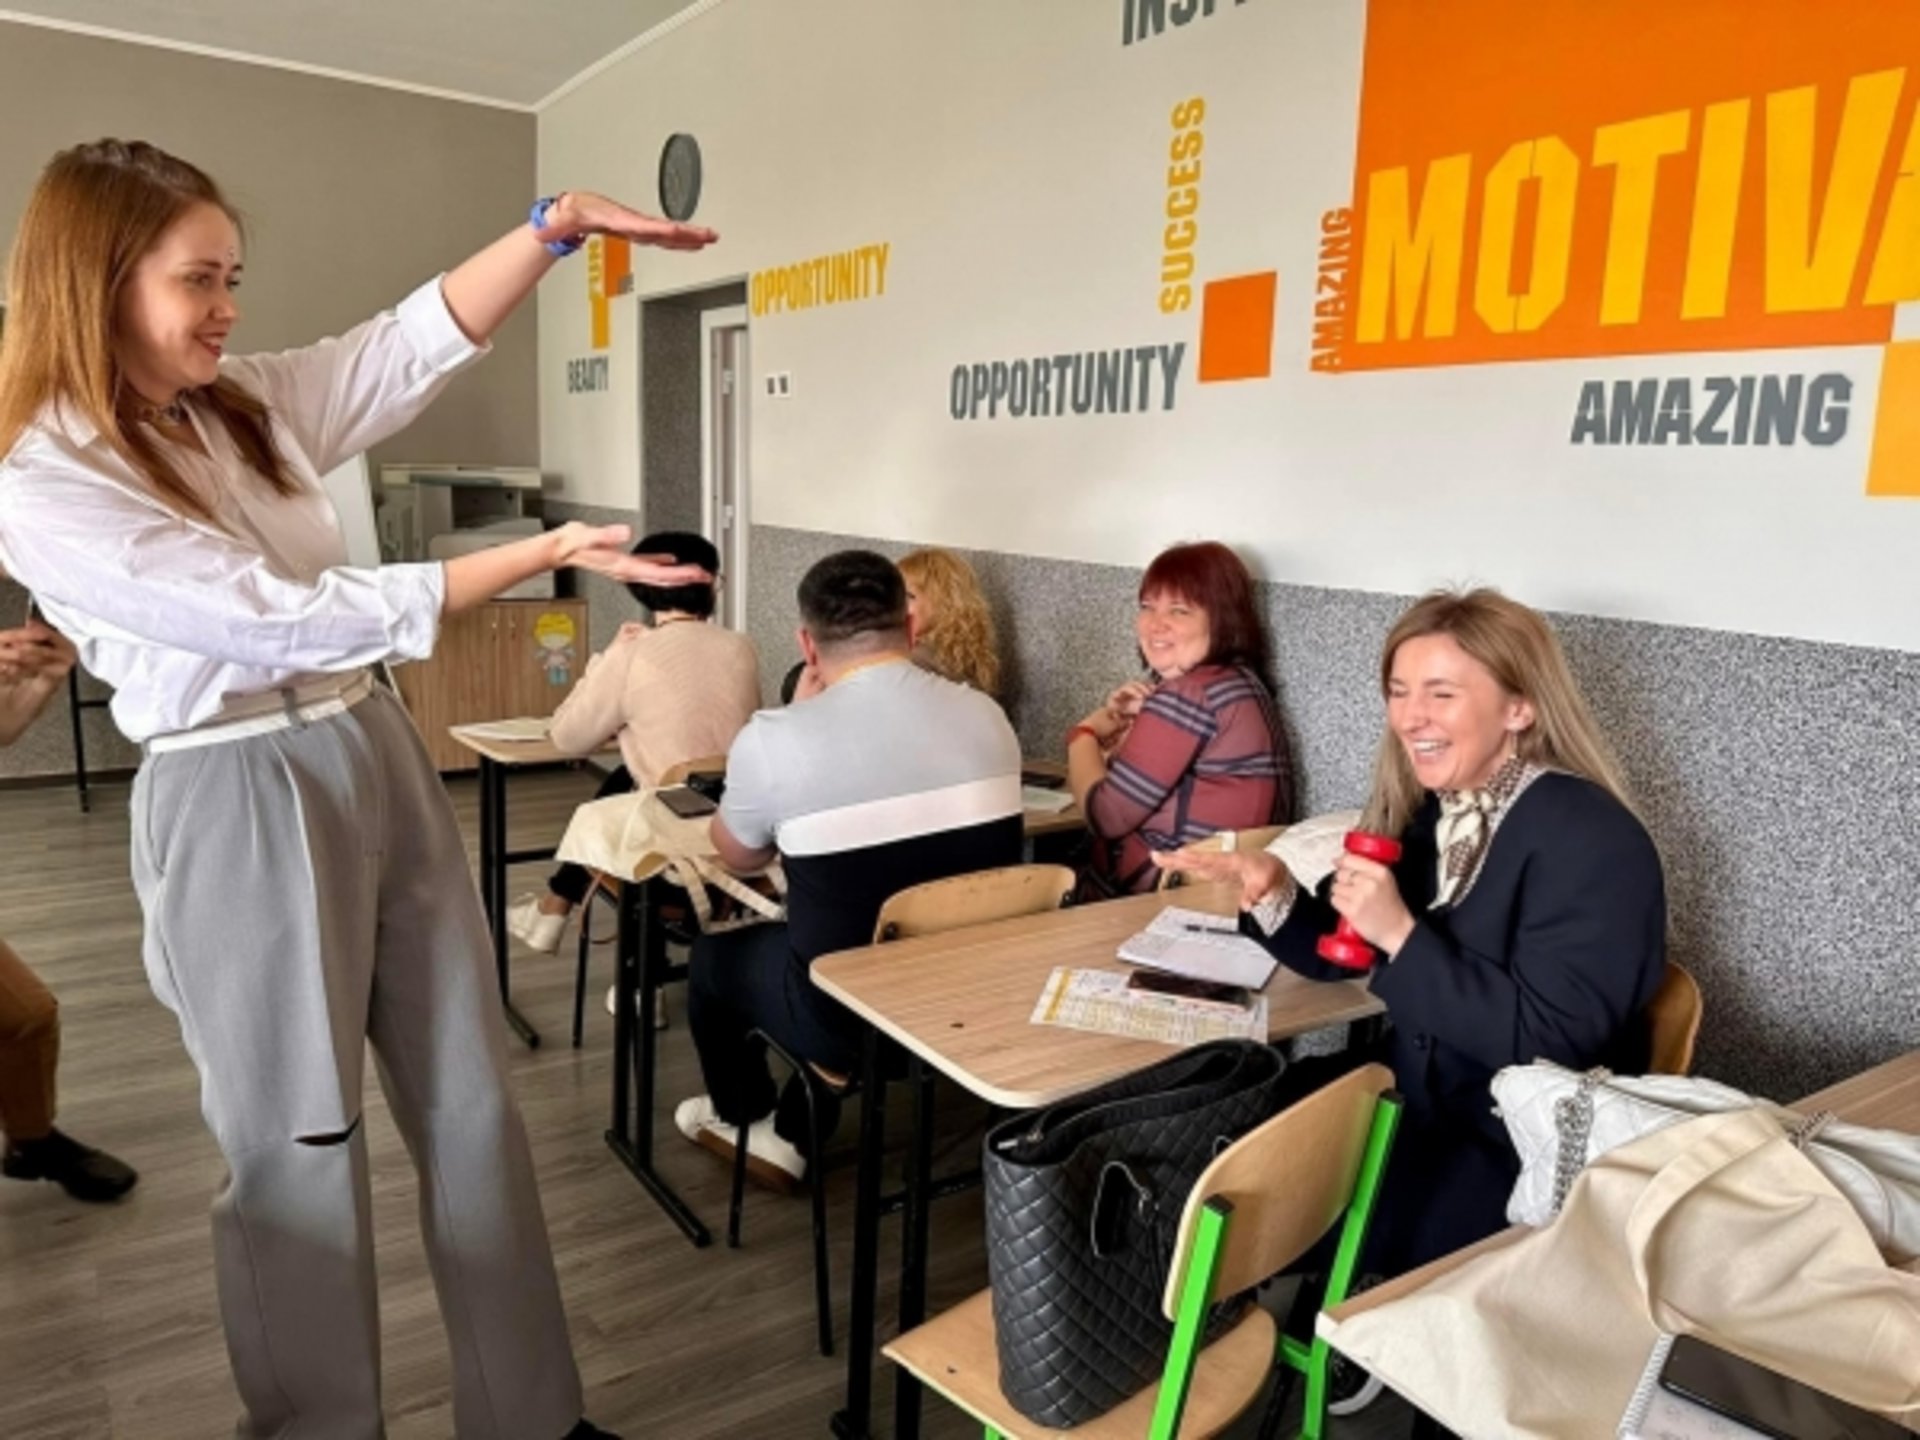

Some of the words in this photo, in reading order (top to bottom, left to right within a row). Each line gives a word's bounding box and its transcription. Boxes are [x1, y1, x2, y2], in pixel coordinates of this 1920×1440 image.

[1159, 97, 1206, 313] SUCCESS
[750, 243, 890, 317] OPPORTUNITY
[1310, 207, 1353, 373] AMAZING
[568, 356, 609, 394] BEAUTY
[950, 342, 1187, 420] OPPORTUNITY
[1570, 373, 1853, 446] AMAZING
